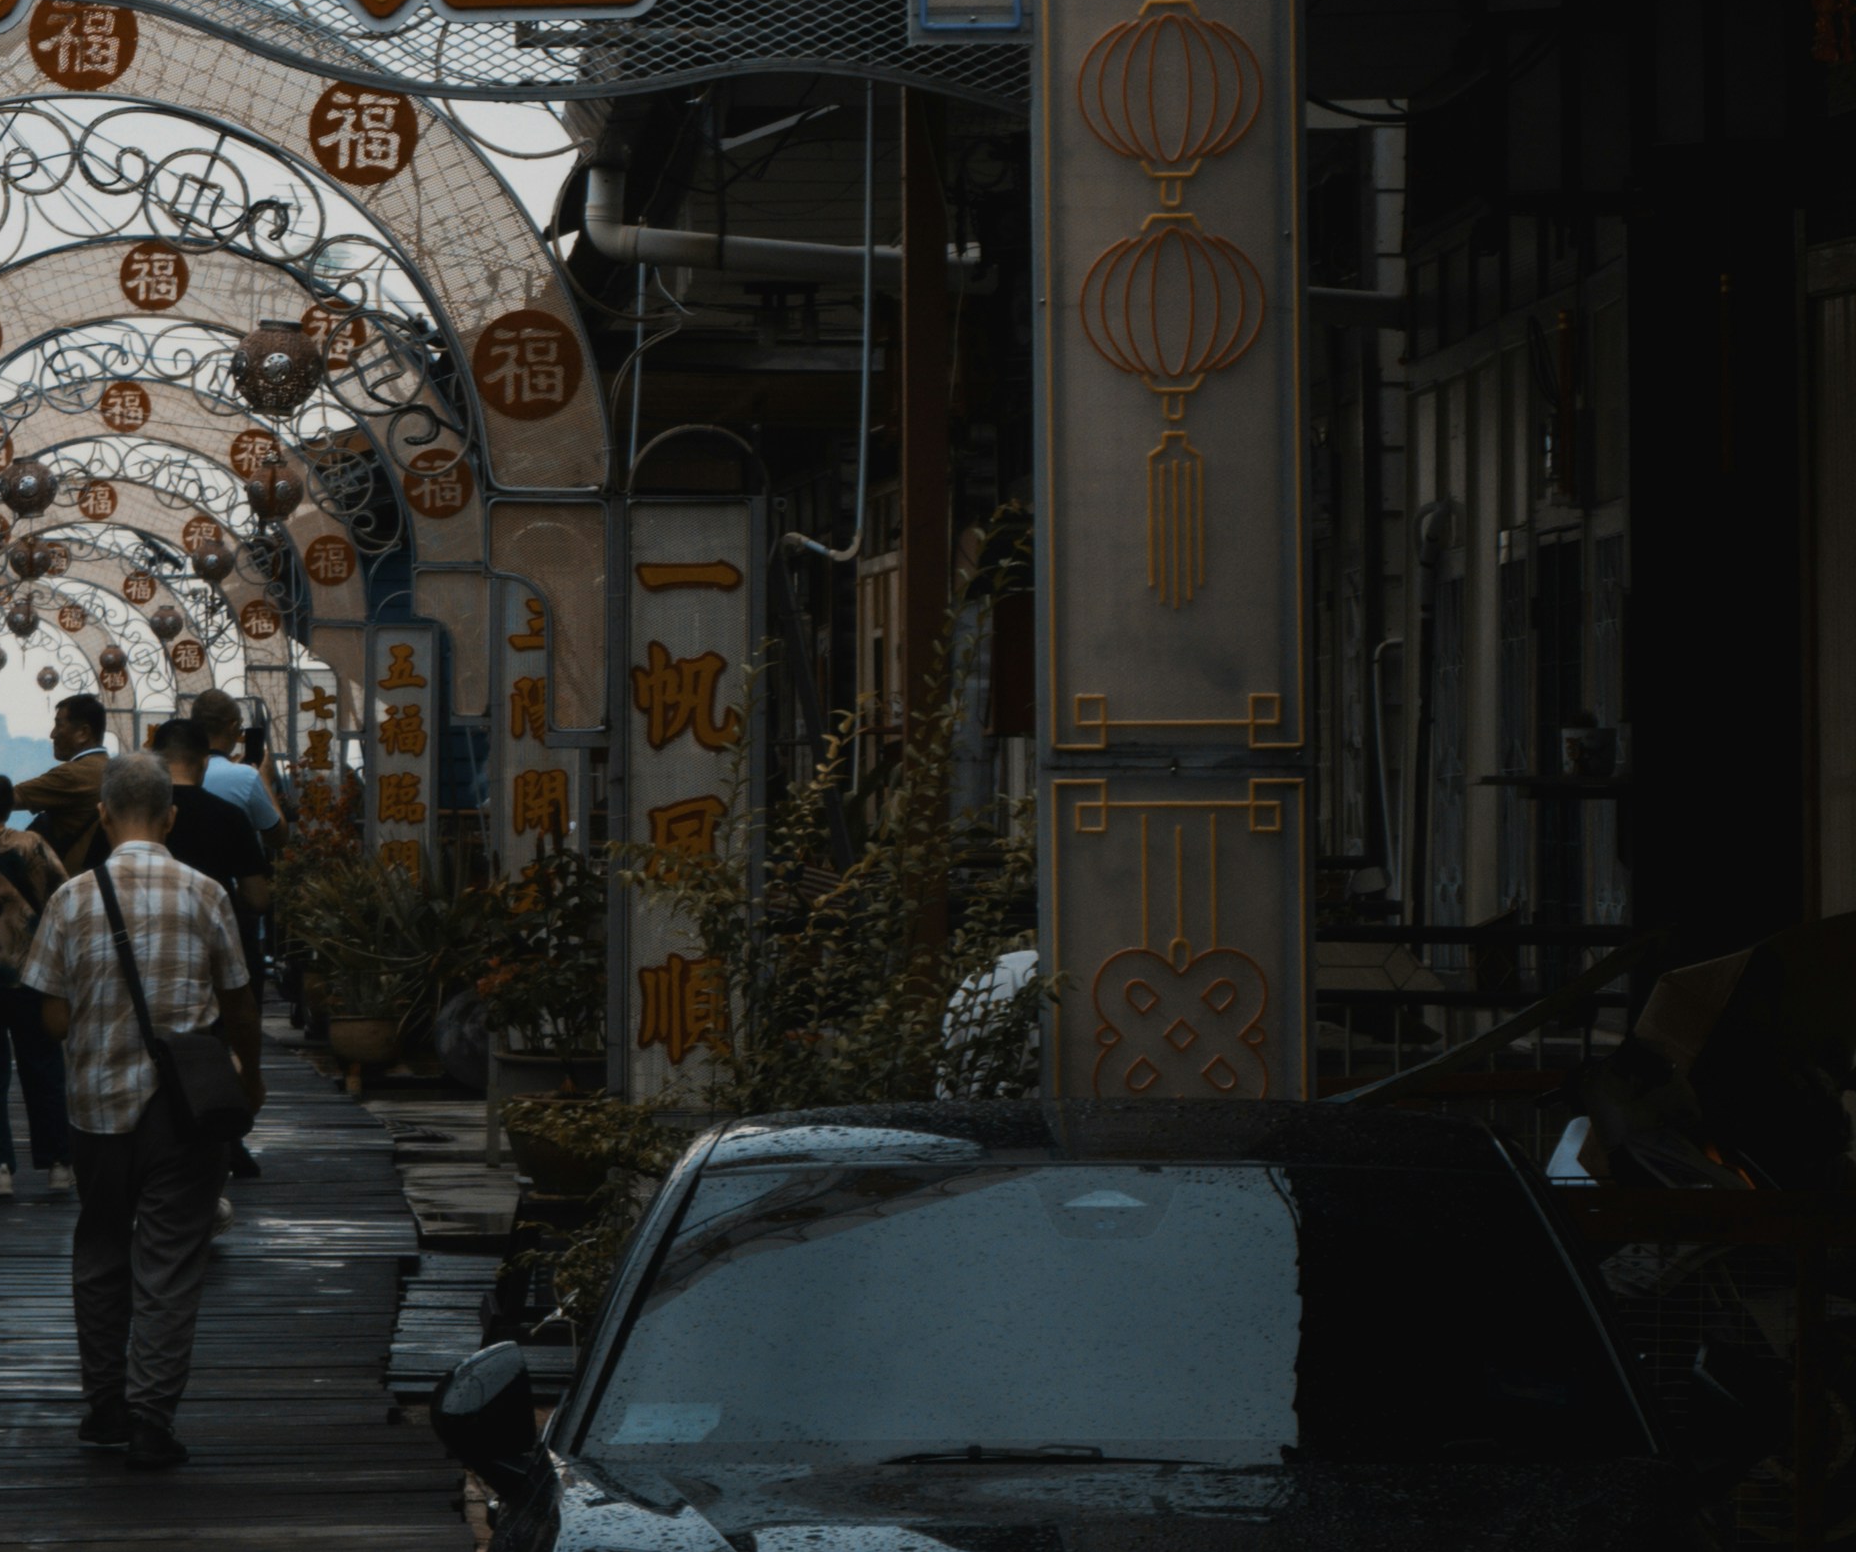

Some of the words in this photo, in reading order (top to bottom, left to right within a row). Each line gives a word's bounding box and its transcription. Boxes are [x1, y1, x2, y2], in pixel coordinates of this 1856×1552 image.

[39, 0, 121, 77] 福
[319, 92, 401, 174] 福
[125, 253, 178, 301] 福
[485, 330, 567, 409] 福
[106, 389, 143, 426] 福
[82, 485, 112, 514] 福
[410, 459, 464, 510] 福
[310, 542, 349, 579] 福
[244, 606, 274, 635] 福
